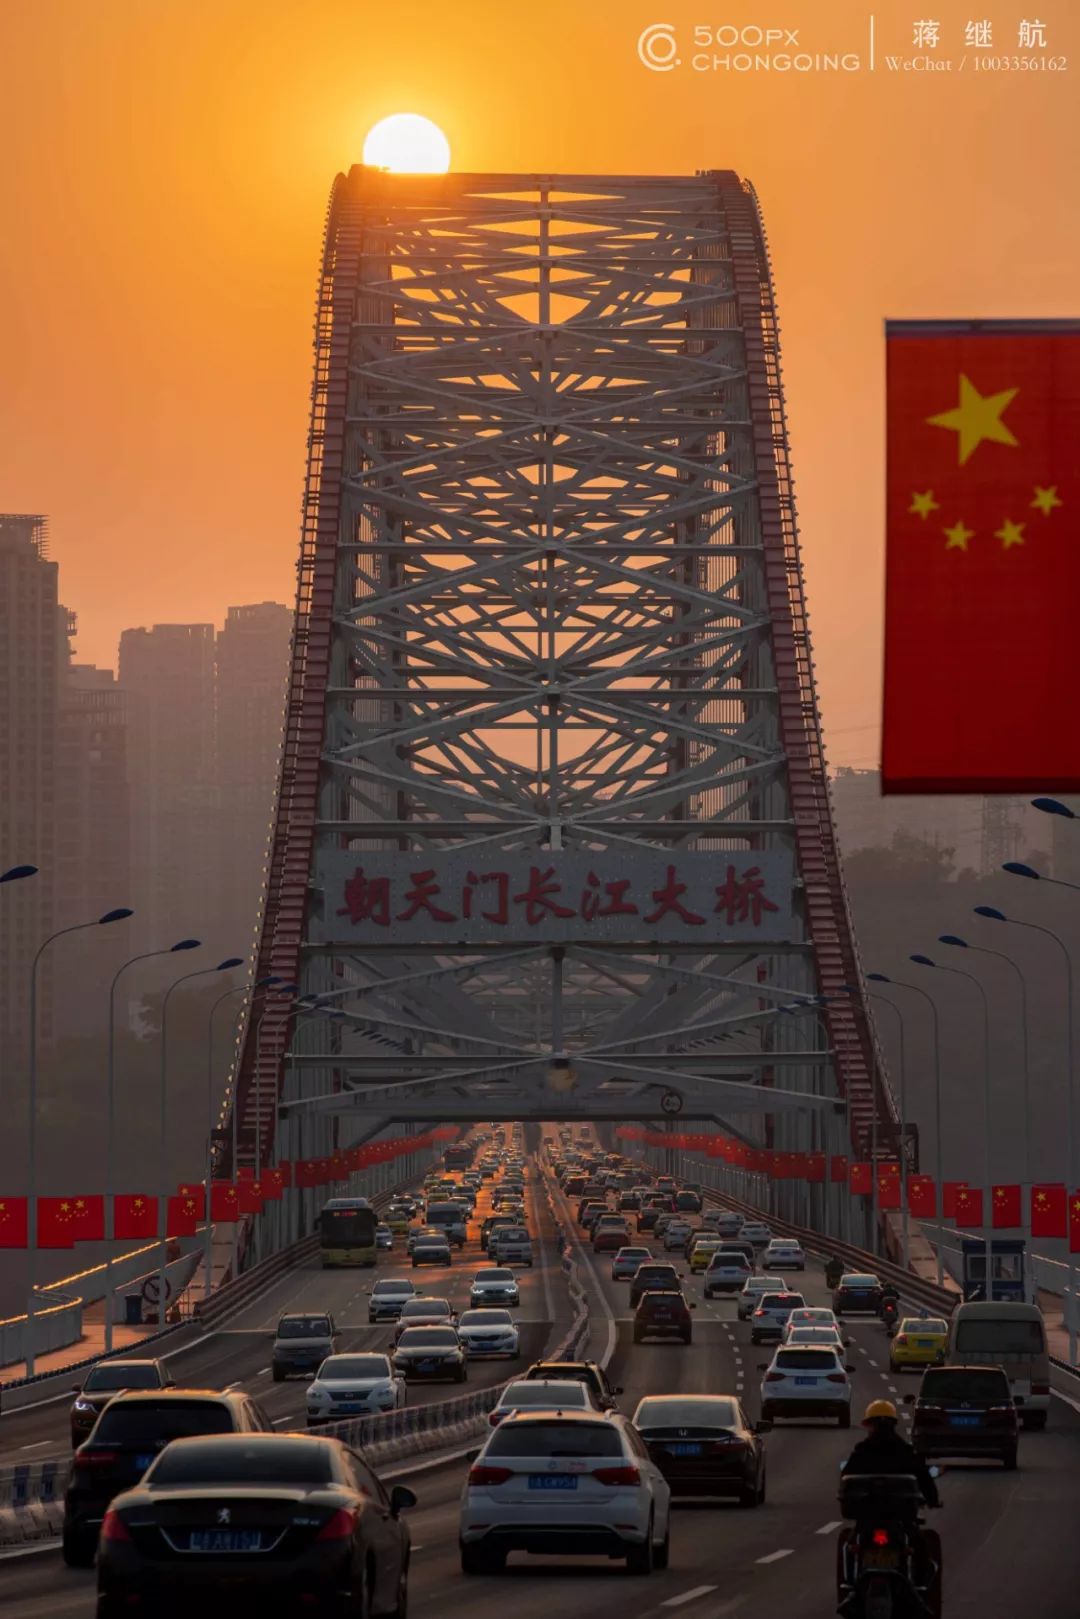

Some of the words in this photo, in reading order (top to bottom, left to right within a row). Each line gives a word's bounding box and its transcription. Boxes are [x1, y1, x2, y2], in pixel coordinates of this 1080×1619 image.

[336, 865, 780, 927] 朝天门长江大桥
